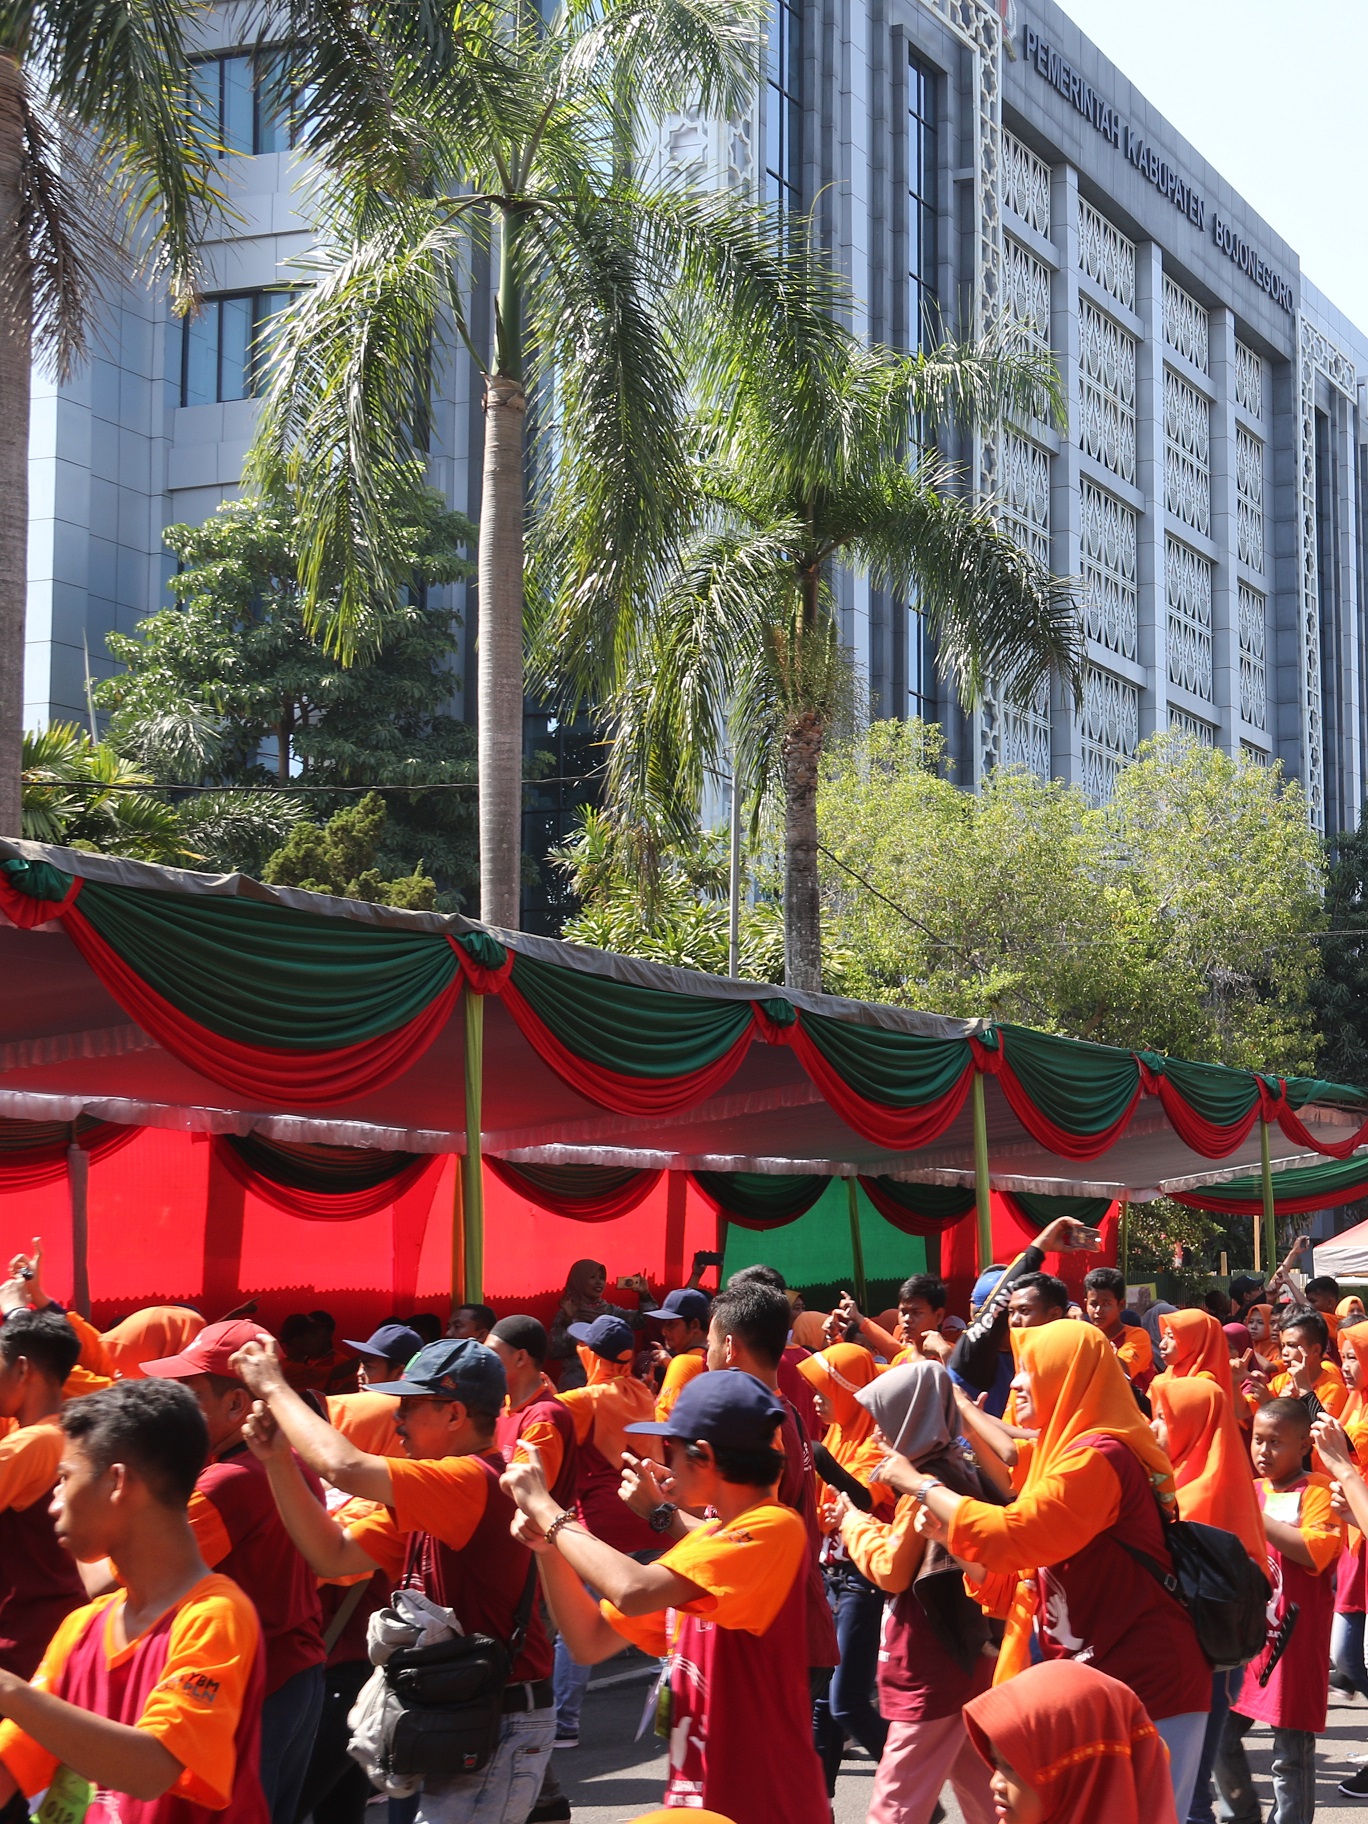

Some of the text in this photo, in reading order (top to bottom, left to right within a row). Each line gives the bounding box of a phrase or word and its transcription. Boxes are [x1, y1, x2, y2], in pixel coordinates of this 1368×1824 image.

[1023, 24, 1295, 314] PEMERINTAH KABUPATEN BOJONEGORO
[183, 1681, 216, 1703] PLN
[188, 1672, 220, 1693] YBM
